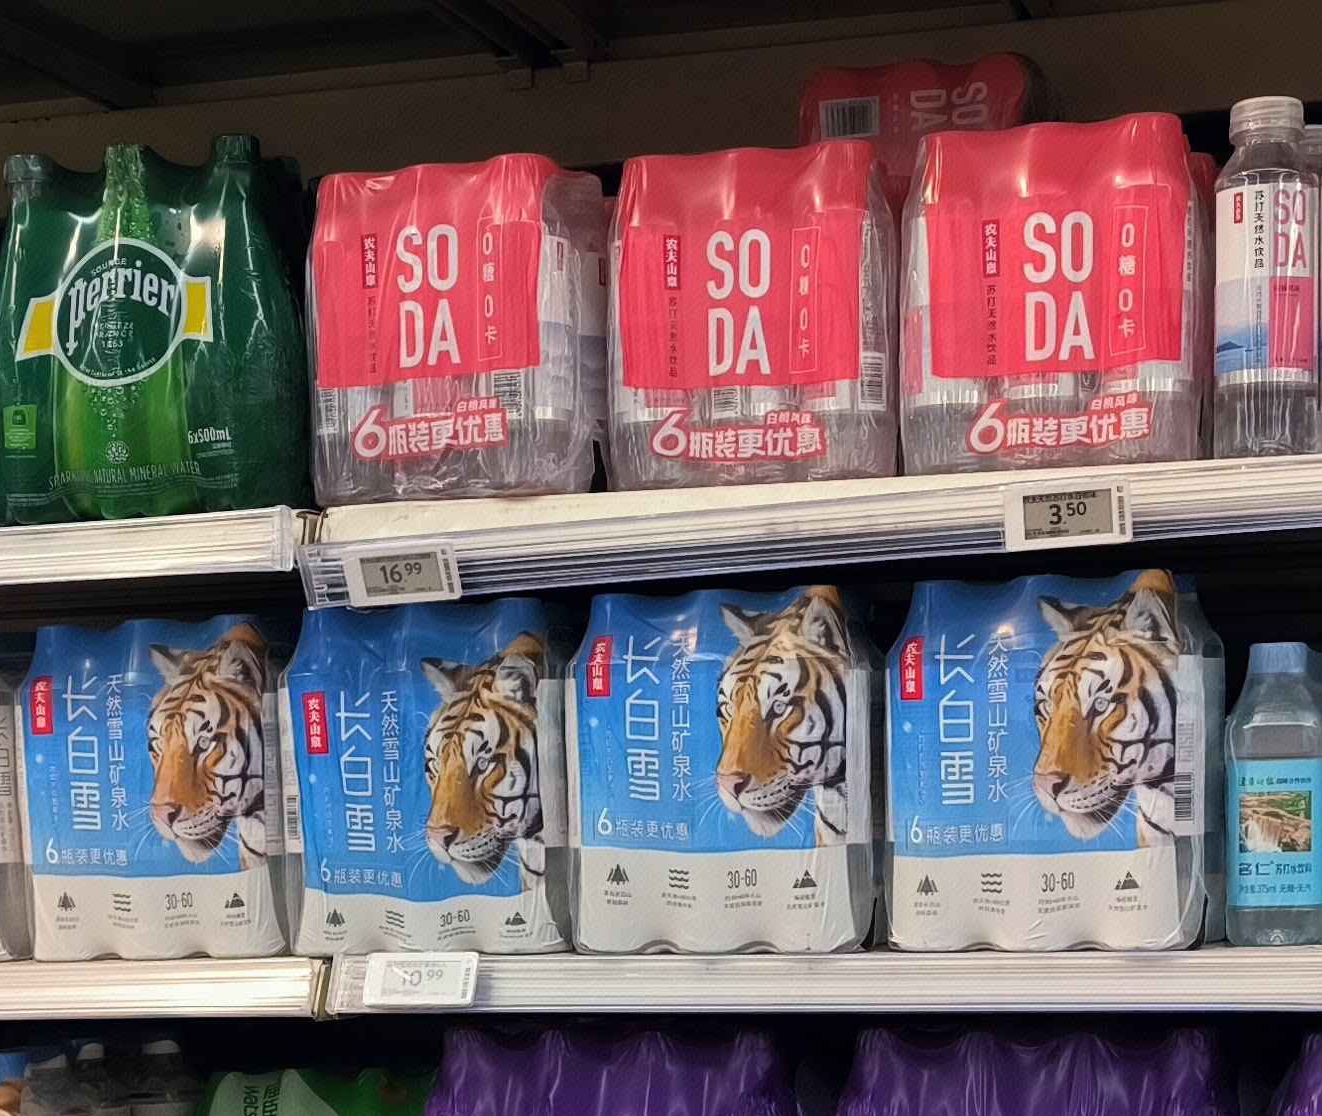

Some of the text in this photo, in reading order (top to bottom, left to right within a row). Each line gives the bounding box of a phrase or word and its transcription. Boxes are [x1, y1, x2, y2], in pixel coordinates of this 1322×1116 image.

[396, 223, 459, 293] SO
[706, 229, 771, 300] SO
[1023, 211, 1094, 283] SO
[1254, 189, 1265, 270] 苏打天然水饮品
[66, 260, 176, 356] Perrier
[399, 298, 461, 368] DA
[707, 306, 772, 376] DA
[1024, 290, 1095, 362] DA
[94, 468, 127, 483] NATURAL
[130, 464, 168, 481] MINERAL
[170, 460, 201, 477] WATER
[106, 673, 130, 831] 天然雪山矿泉水
[623, 634, 662, 801] 长白雪
[670, 630, 695, 802] 天然雪山矿泉水
[934, 634, 976, 805] 长白雪
[987, 632, 1010, 803] 天然雪山矿泉水
[61, 675, 102, 834] 长白雪
[335, 690, 376, 853] 长白雪
[380, 690, 405, 852] 天然雪山矿泉水
[46, 837, 129, 867] 6瓶装更优惠
[597, 807, 690, 841] 6瓶装更优惠
[908, 809, 1004, 844] 6瓶装更优惠
[320, 857, 403, 889] 6瓶装更优惠
[726, 869, 758, 889] 30-60
[1041, 872, 1076, 892] 30-60
